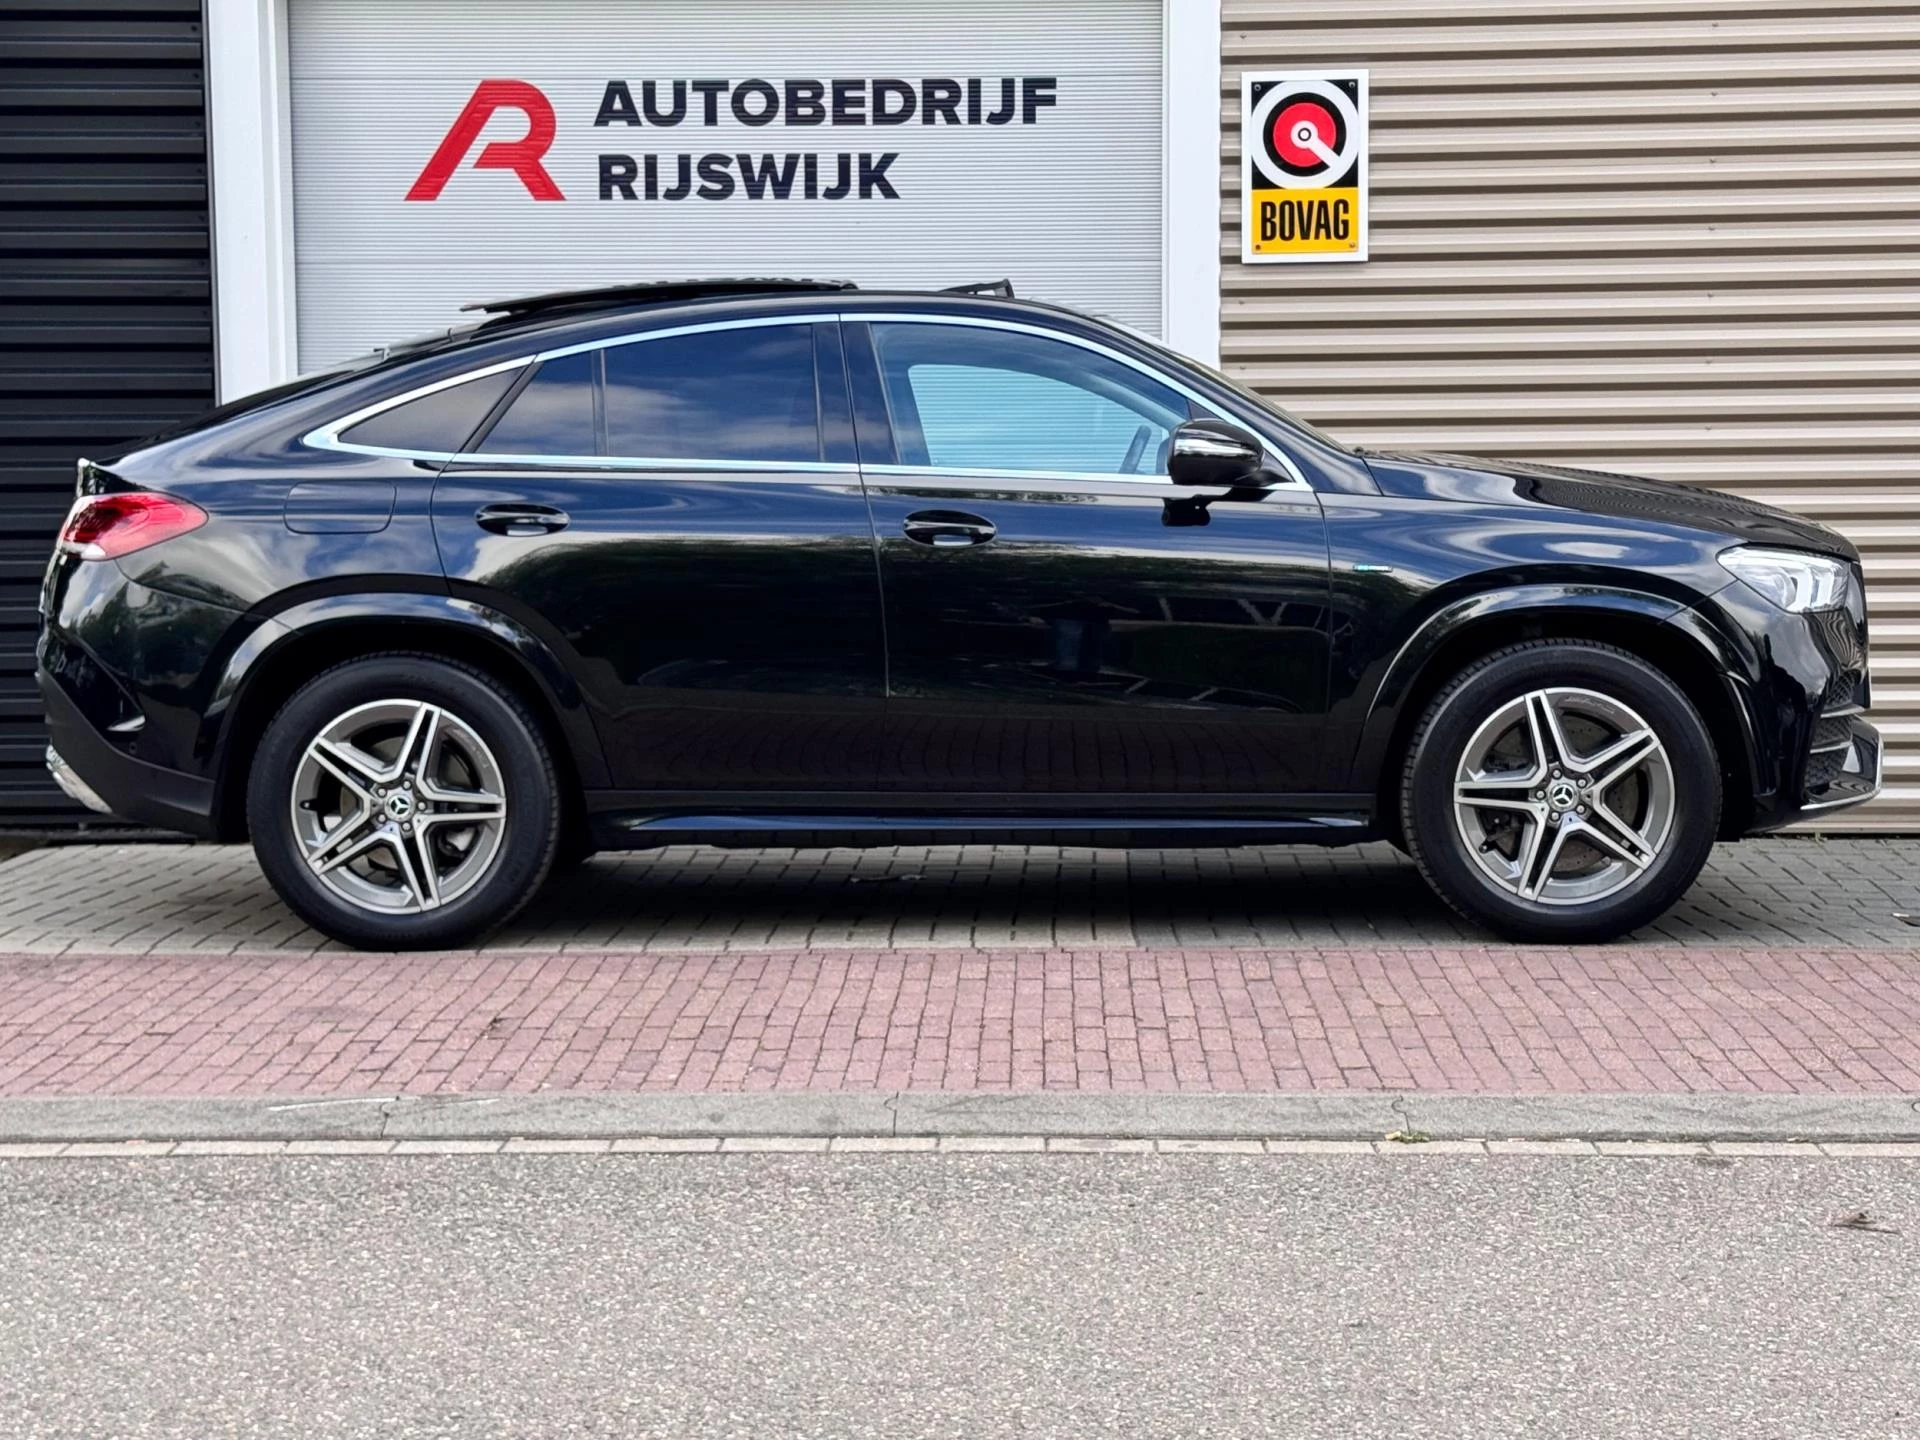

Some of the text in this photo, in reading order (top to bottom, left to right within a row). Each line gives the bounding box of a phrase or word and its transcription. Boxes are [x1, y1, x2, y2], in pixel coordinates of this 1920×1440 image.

[593, 77, 1057, 127] AUTOBEDRIJF
[597, 153, 900, 201] RIJSWIJK
[1260, 198, 1349, 241] BOVAG
